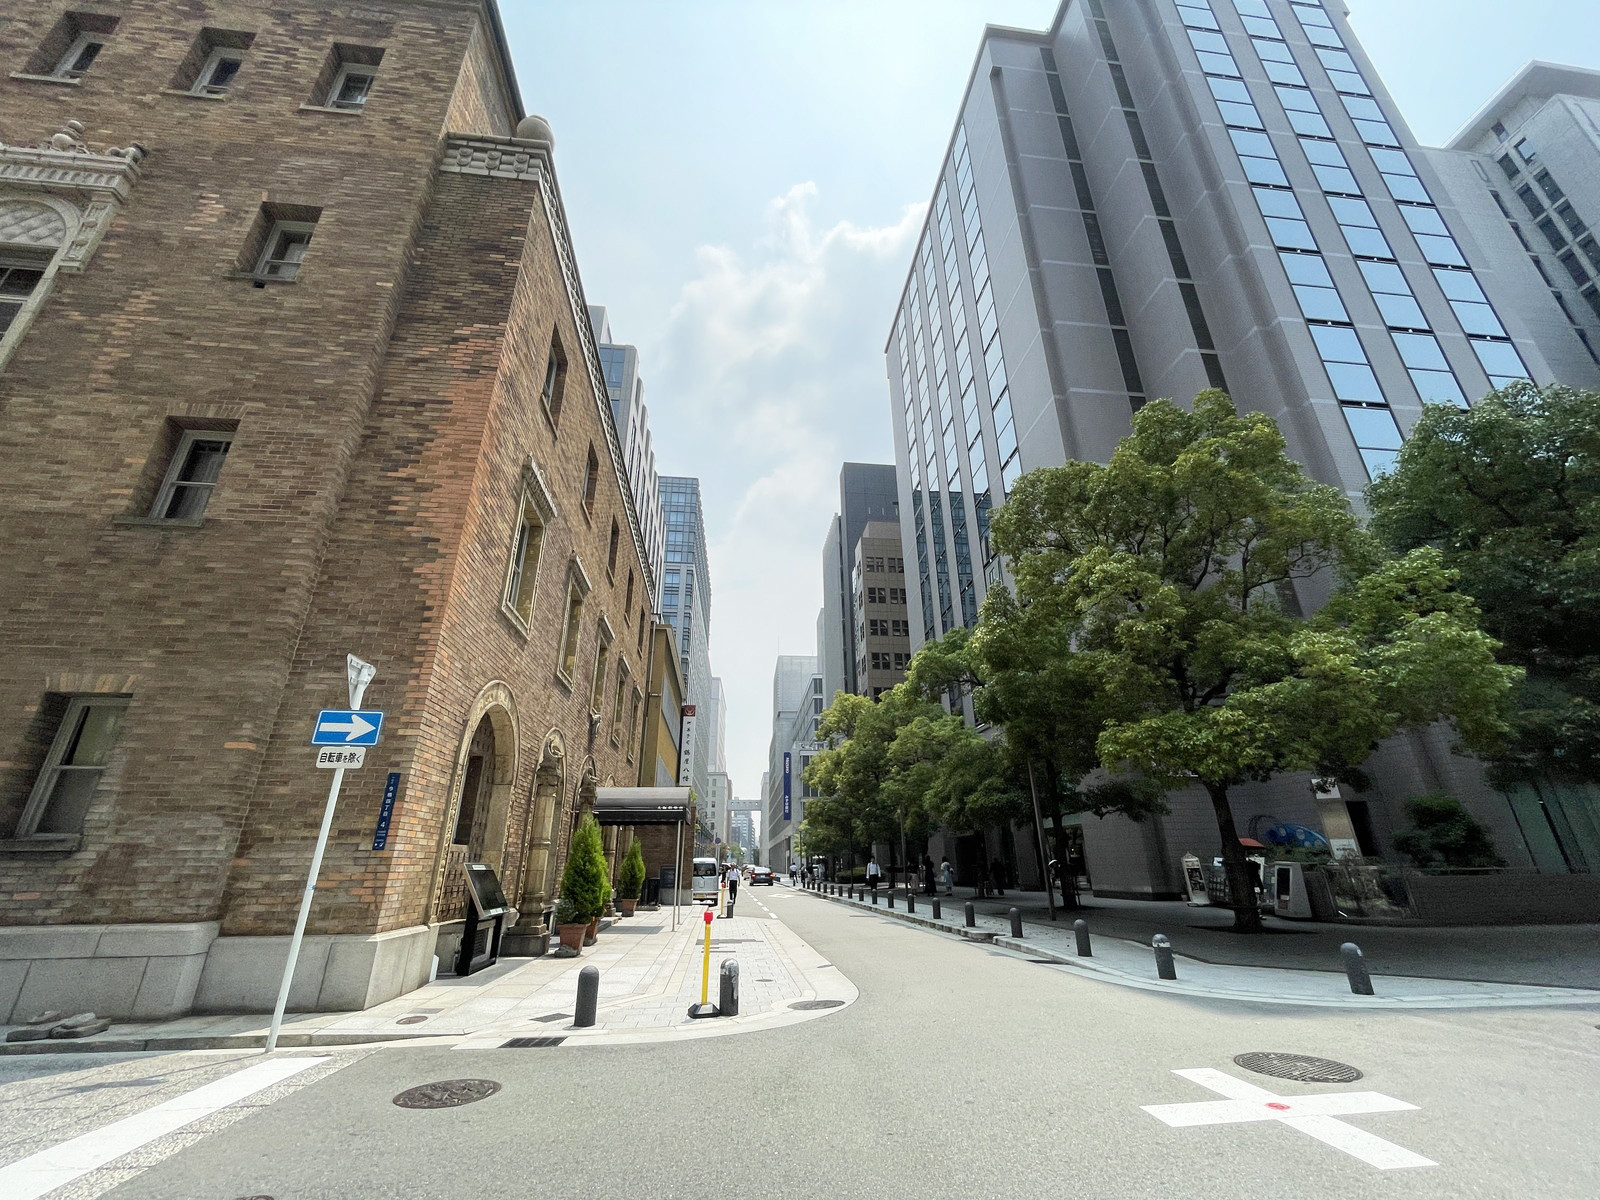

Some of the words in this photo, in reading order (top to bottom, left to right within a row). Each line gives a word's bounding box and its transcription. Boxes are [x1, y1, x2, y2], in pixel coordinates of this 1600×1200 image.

[319, 752, 362, 764] 自転車を除く
